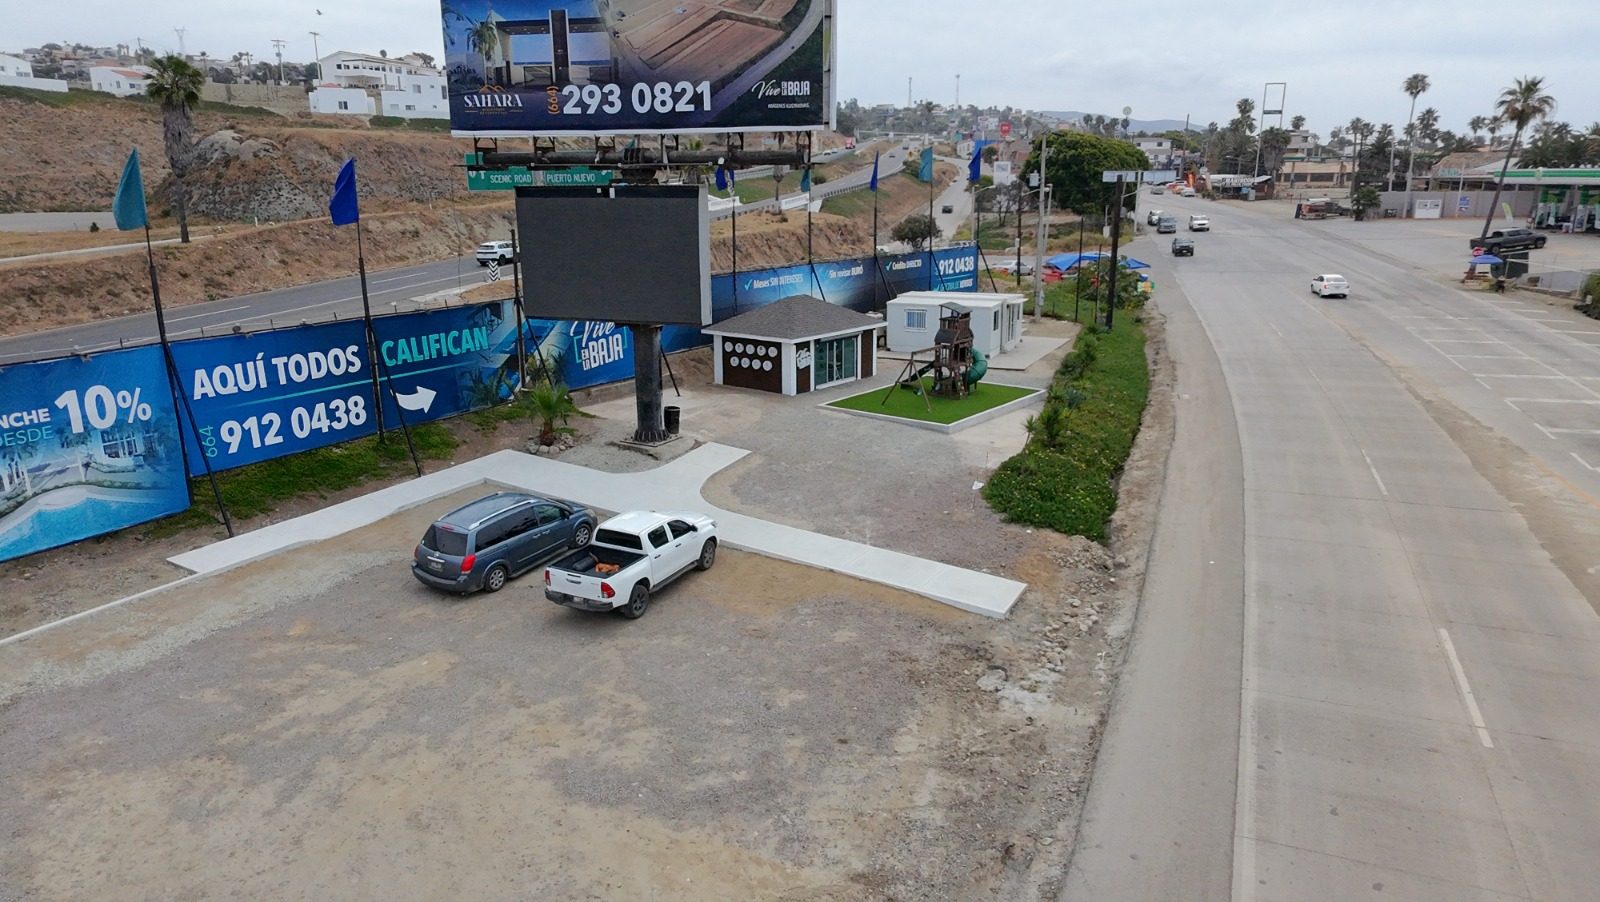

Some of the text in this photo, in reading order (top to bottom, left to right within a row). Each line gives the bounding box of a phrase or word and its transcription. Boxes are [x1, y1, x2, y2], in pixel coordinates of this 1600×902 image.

[464, 94, 523, 108] SAHARA
[547, 81, 711, 114] (664) 293 0821
[751, 80, 781, 99] Vive
[788, 81, 810, 96] BAJA
[490, 174, 512, 184] SCENIC
[514, 174, 532, 183] ROAD
[546, 173, 596, 183] PUERTO NUEVO
[939, 258, 954, 275] 912
[955, 256, 974, 273] 0438
[381, 326, 489, 367] CALIFICAN
[570, 321, 616, 348] Vive
[589, 333, 624, 368] BAJA
[193, 345, 362, 400] AQUÍ TODOS
[54, 384, 152, 434] 10%
[0, 426, 55, 447] ESDE
[199, 395, 367, 457] 664 912 0438
